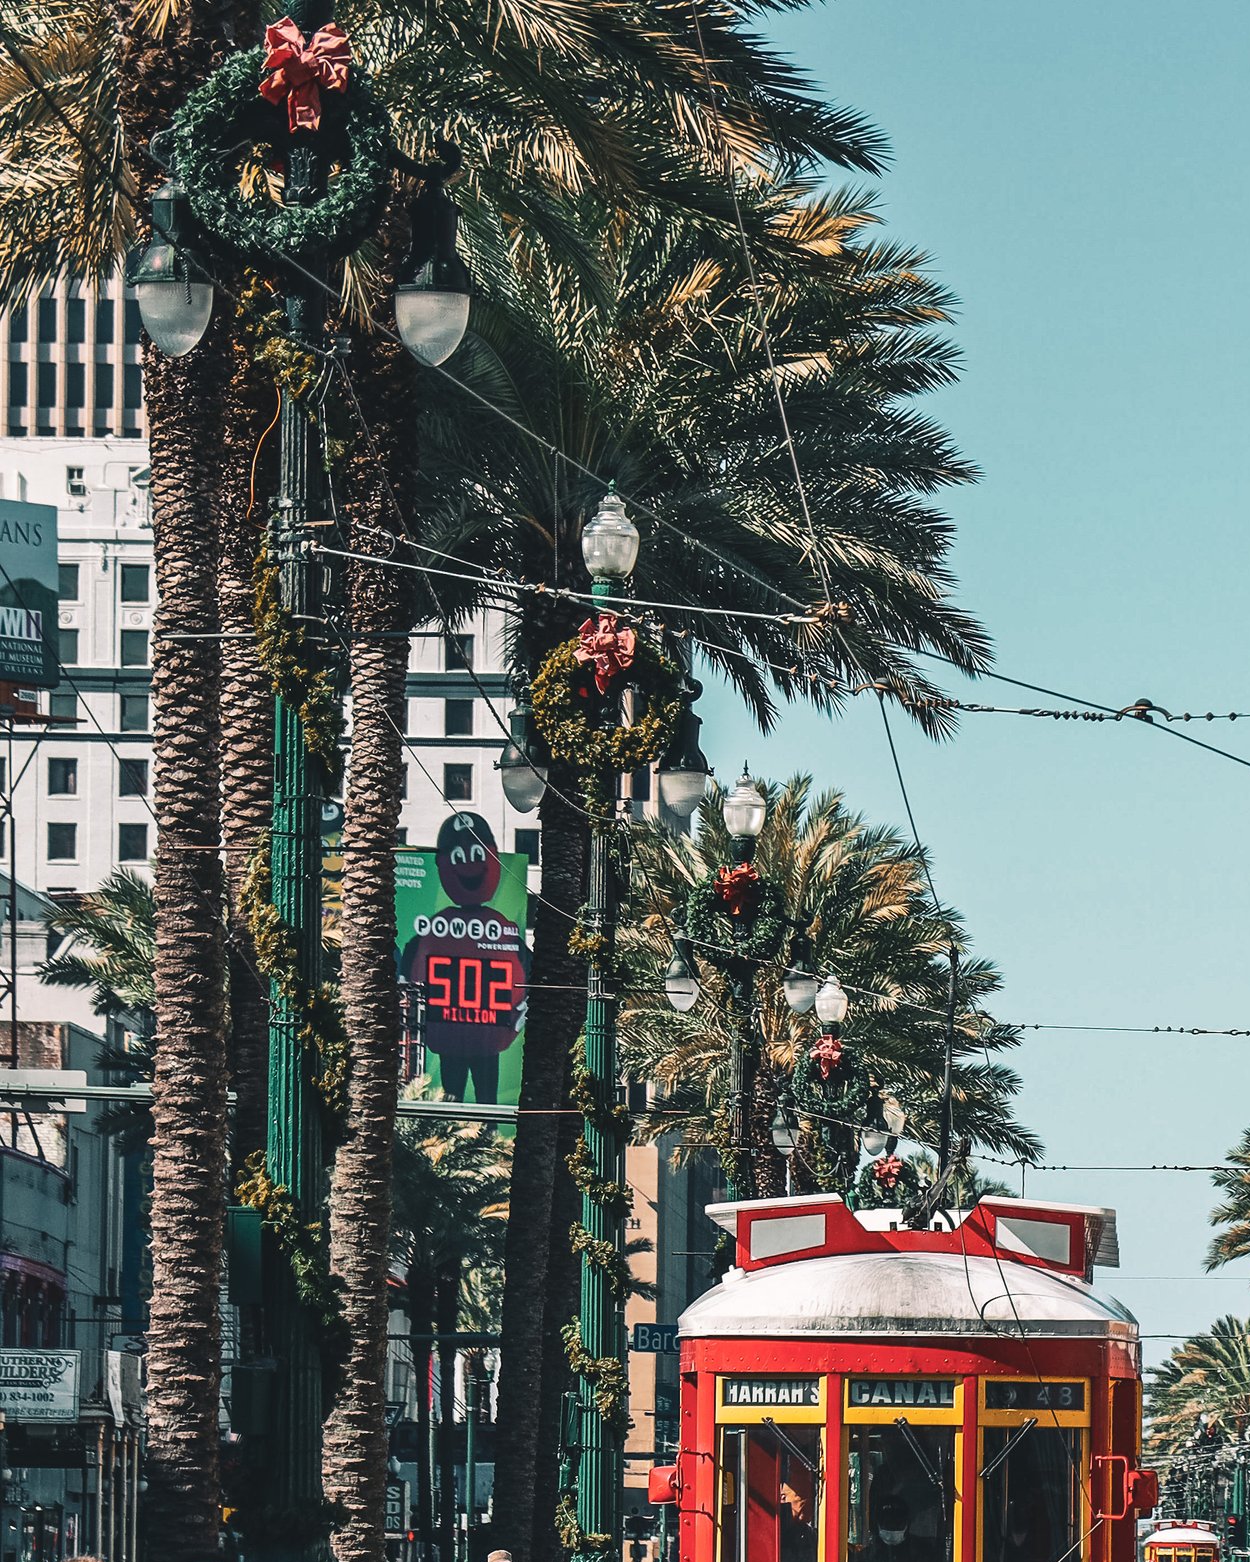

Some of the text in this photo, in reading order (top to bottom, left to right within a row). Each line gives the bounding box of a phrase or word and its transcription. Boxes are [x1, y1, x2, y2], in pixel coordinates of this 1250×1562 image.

[1, 641, 43, 654] NATIONAL
[9, 653, 43, 665] MUSEUM
[416, 917, 501, 940] POWER
[429, 956, 513, 1011] 502
[443, 1007, 497, 1024] MILLION
[10, 1391, 55, 1403] 834-1002
[727, 1380, 820, 1404] HARRAH'S
[851, 1381, 953, 1405] CANAL
